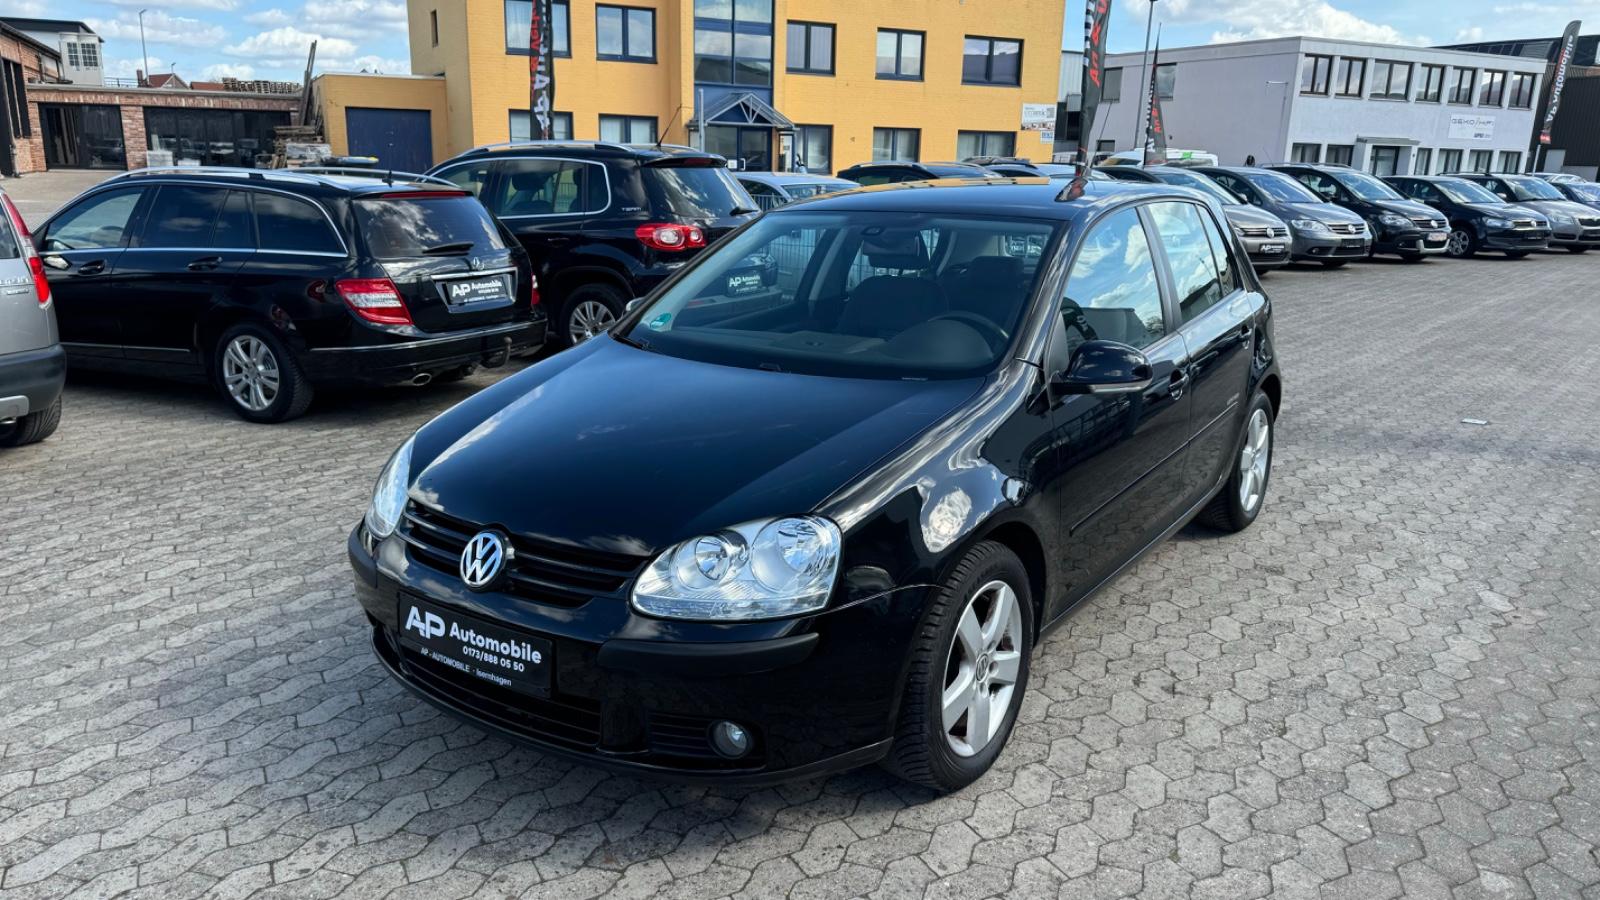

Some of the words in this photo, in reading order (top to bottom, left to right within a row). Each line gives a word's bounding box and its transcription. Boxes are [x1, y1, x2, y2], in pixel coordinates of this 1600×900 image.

[452, 283, 471, 297] AP
[405, 605, 446, 639] AP
[450, 622, 542, 664] Automobile
[462, 645, 498, 665] 0173/888
[500, 658, 511, 670] 05
[513, 661, 525, 672] 50
